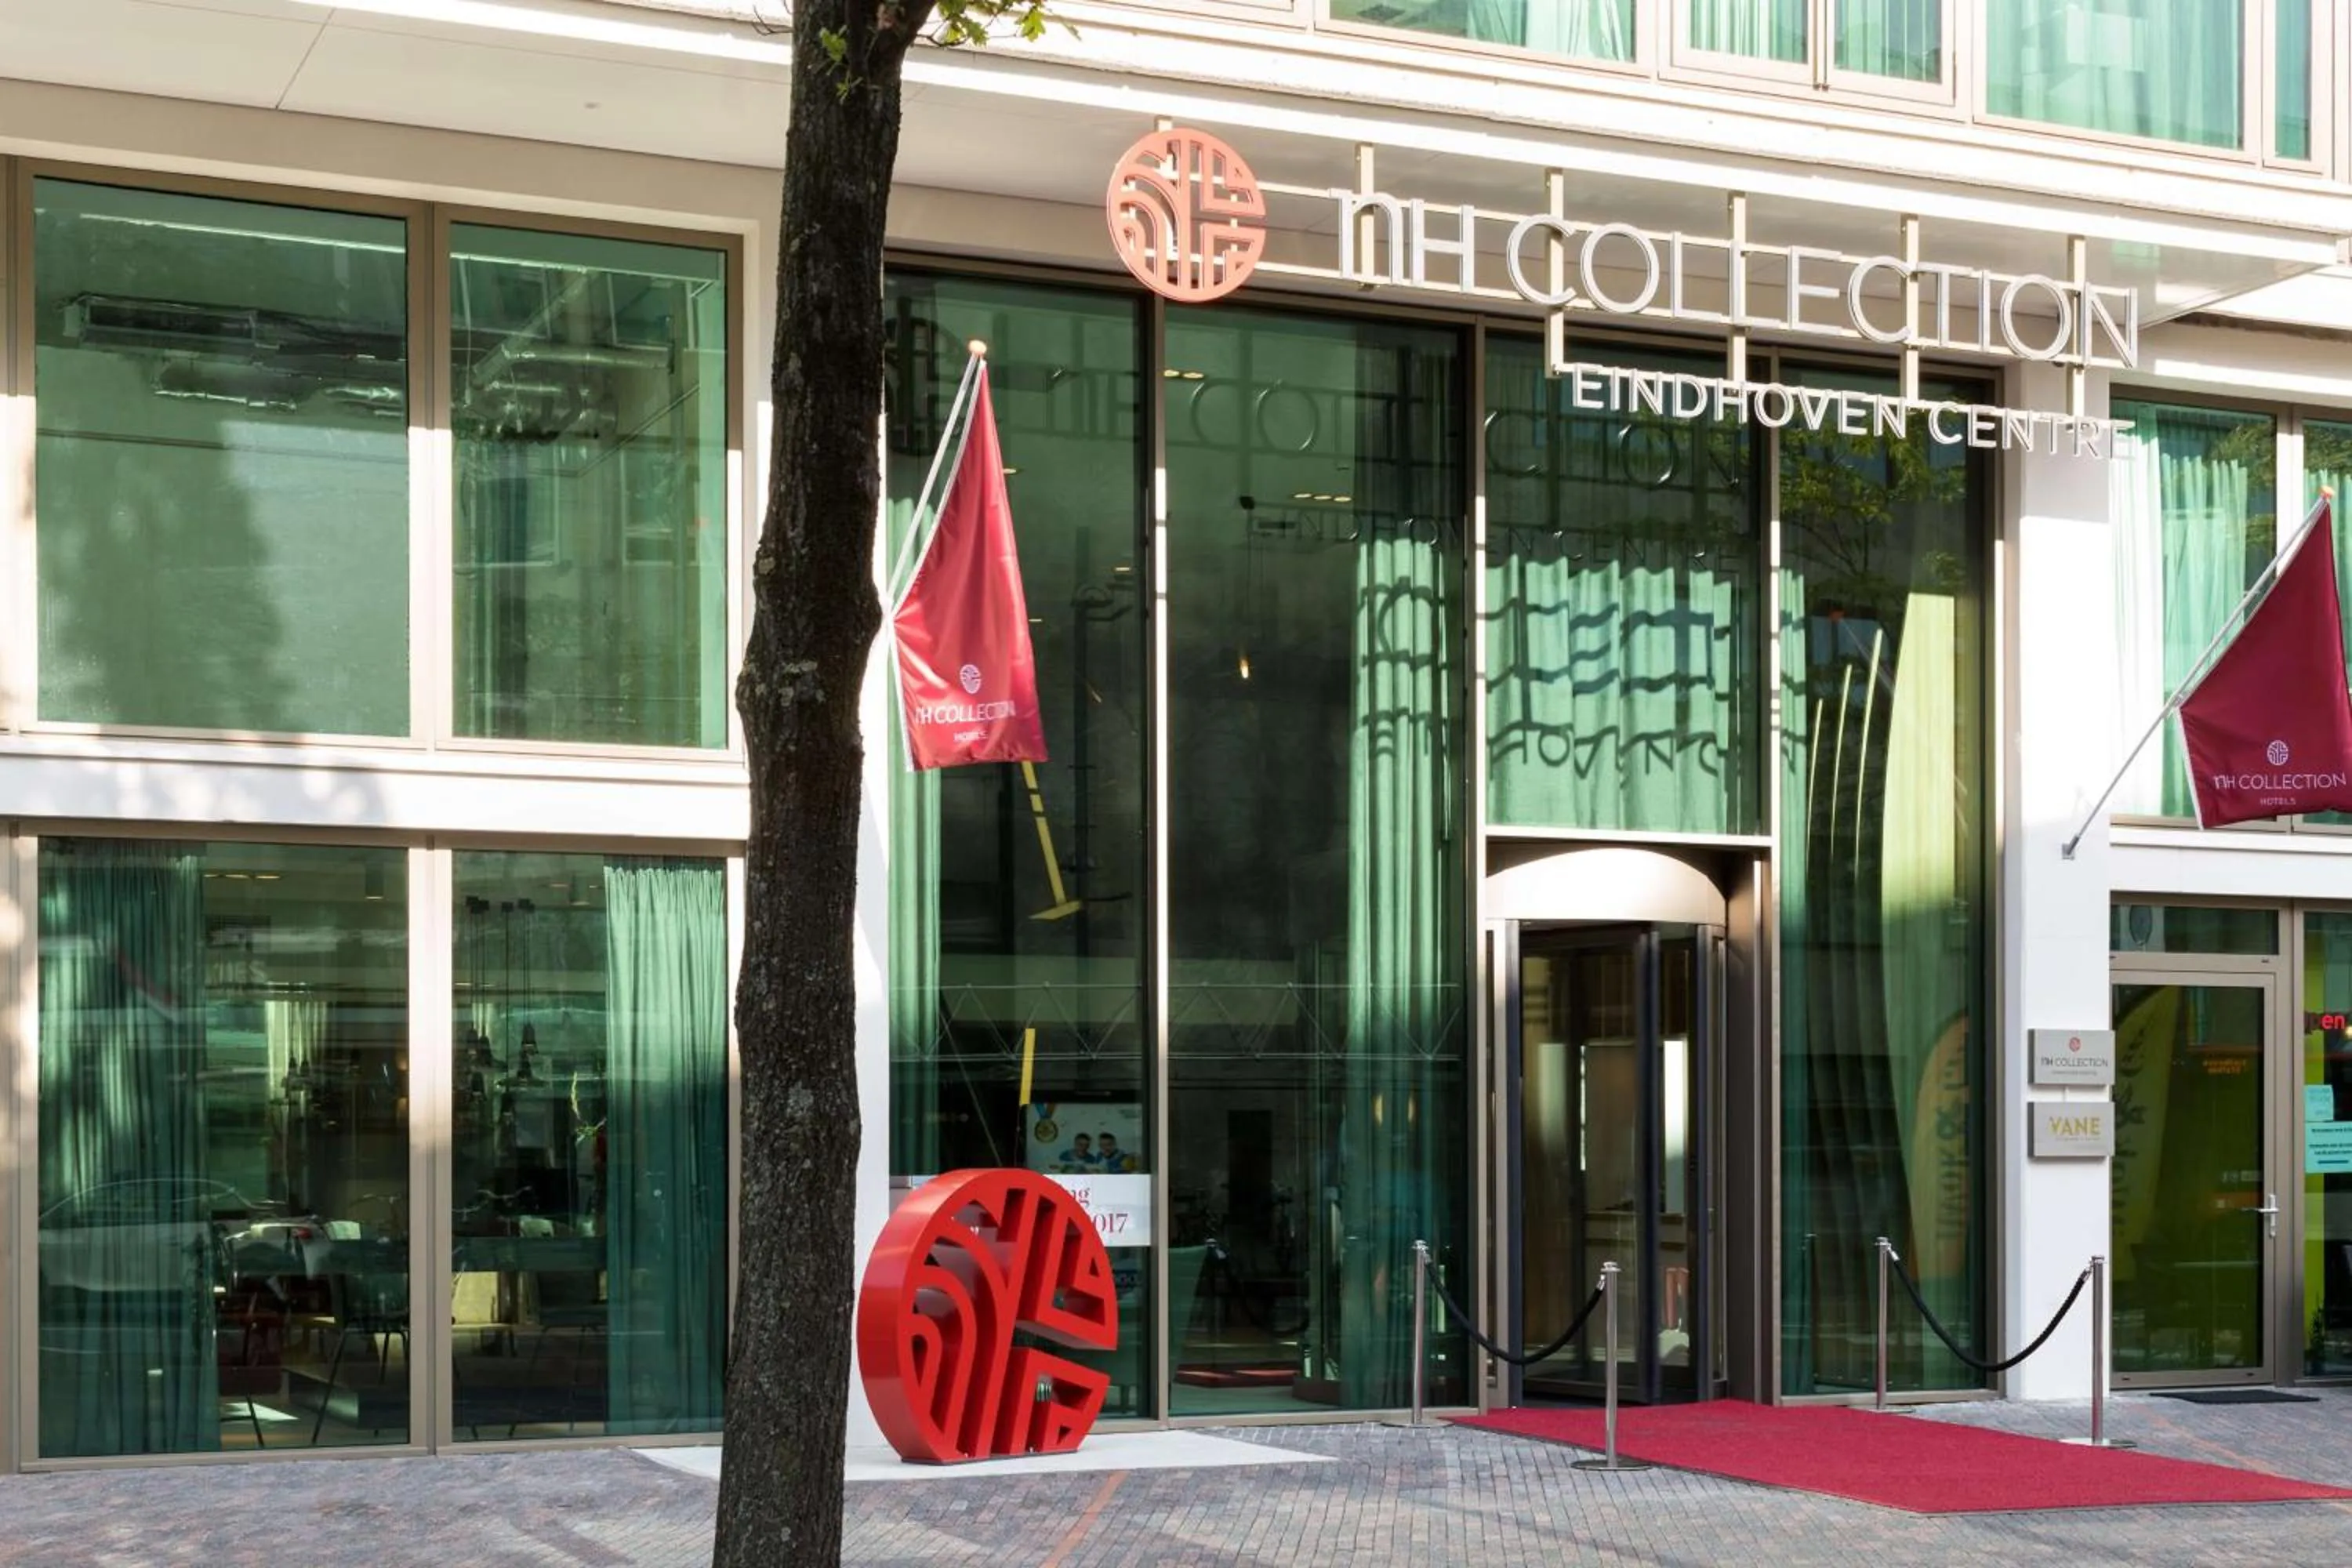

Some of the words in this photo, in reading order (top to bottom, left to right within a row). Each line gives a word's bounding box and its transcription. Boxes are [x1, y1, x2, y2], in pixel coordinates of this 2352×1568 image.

[1506, 213, 2138, 368] COLLECTION
[1570, 362, 1908, 439] EINDHOVEN
[1929, 401, 2136, 461] CENTRE
[2238, 772, 2347, 790] COLLECTION
[2259, 797, 2296, 807] HOTELS
[2055, 1056, 2108, 1067] COLLECTION
[2049, 1116, 2101, 1136] VANE
[1093, 1213, 1128, 1234] 017
